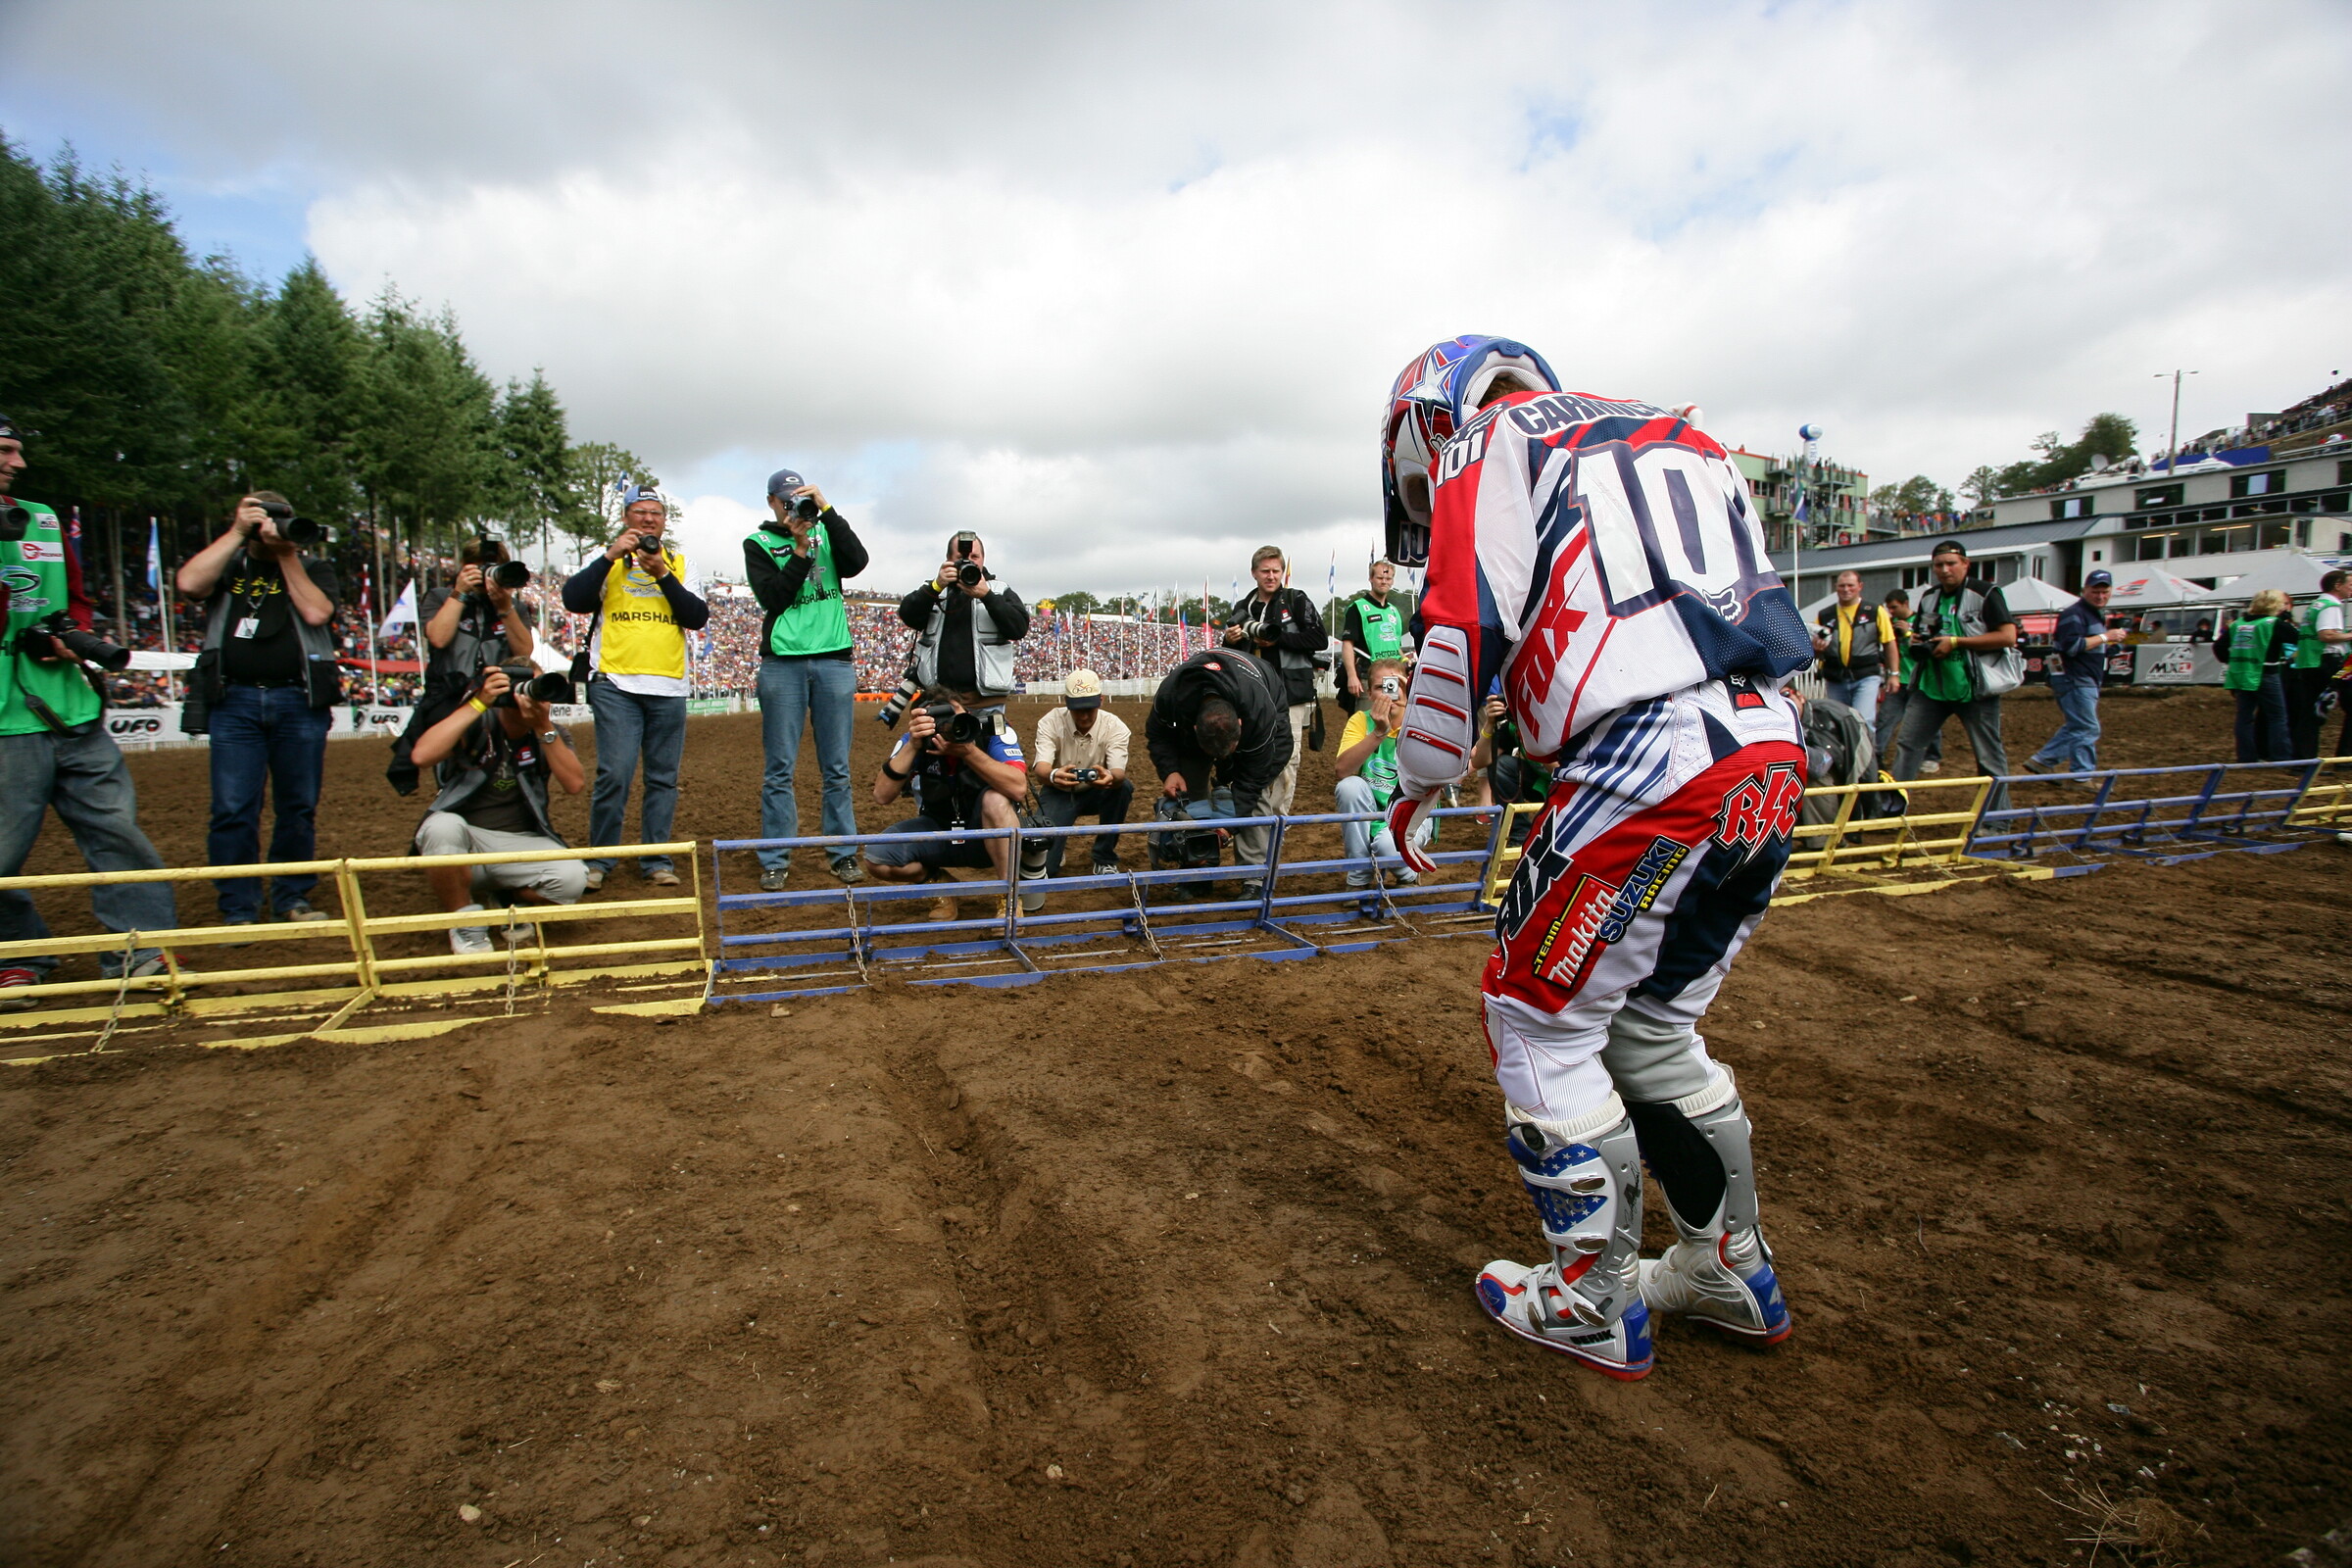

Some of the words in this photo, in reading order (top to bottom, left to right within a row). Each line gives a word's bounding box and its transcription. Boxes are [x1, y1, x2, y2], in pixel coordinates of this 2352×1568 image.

[1436, 429, 1485, 488] 101
[1576, 447, 1776, 606] 101
[110, 718, 160, 734] UFO
[371, 714, 400, 724] UFO
[1598, 838, 1679, 942] SUZUKI
[1639, 846, 1688, 909] RACING
[1535, 920, 1562, 966] TEAM
[1546, 888, 1621, 986] makita
[1550, 1190, 1588, 1218] RC
